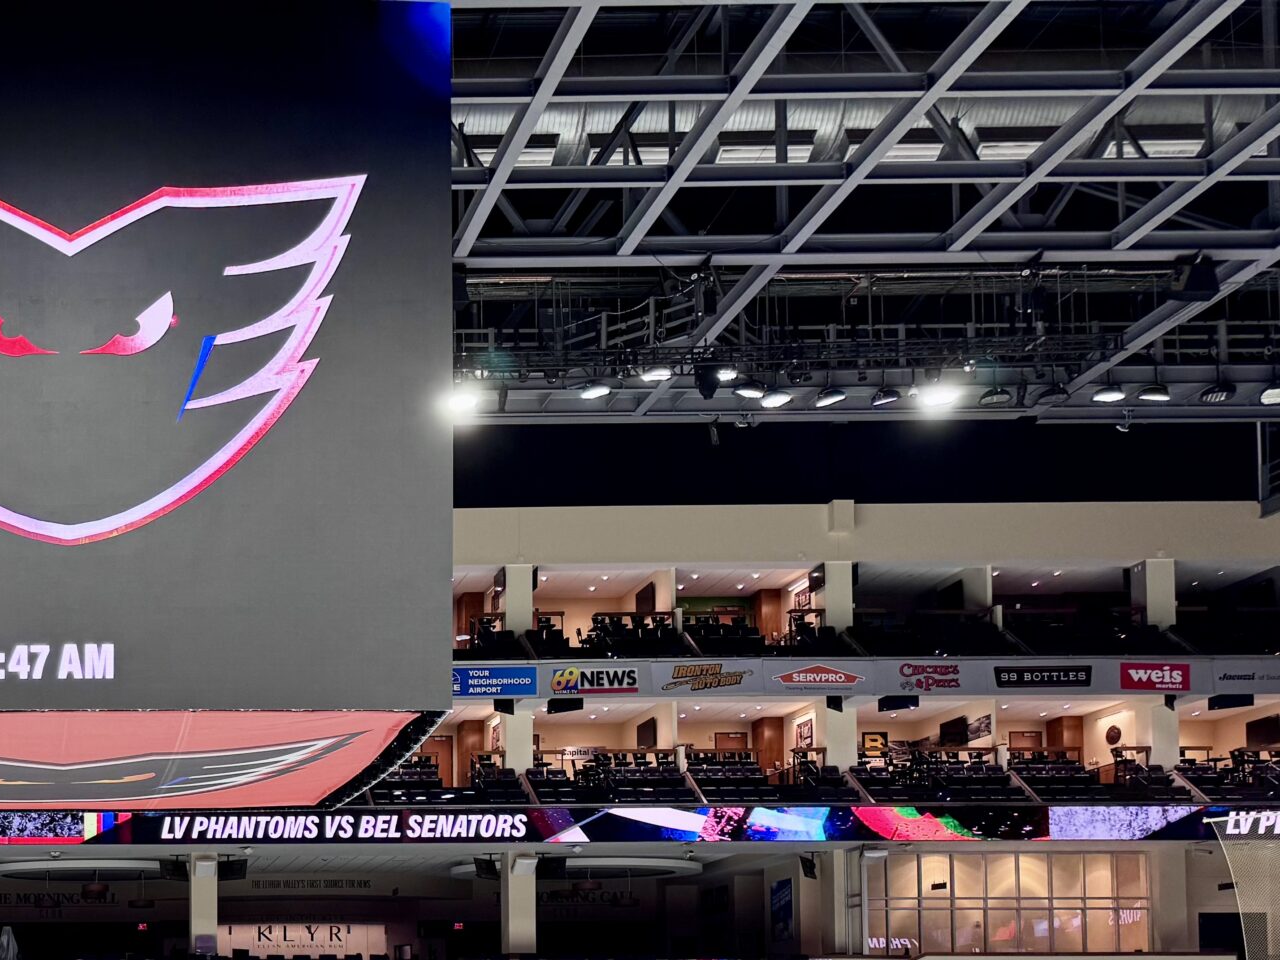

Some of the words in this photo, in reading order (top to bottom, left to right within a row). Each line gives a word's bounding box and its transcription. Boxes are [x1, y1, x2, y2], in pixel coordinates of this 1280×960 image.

[57, 643, 115, 679] AM
[551, 666, 579, 691] 69
[580, 669, 637, 687] NEWS
[672, 663, 722, 679] IRONTON
[792, 672, 845, 682] SERVPRO
[1000, 672, 1018, 681] 99
[1023, 672, 1087, 681] BOTTLES
[1127, 666, 1183, 683] weis
[1219, 672, 1256, 681] Jacuzzi
[468, 677, 532, 685] NEIGHBORHOOD
[691, 678, 719, 691] AUTO
[719, 675, 744, 688] BODY
[468, 686, 502, 694] AIRPORT
[161, 816, 192, 839] LV
[192, 815, 321, 839] PHANTOMS
[324, 815, 354, 838] VS
[358, 815, 402, 839] BEL
[406, 814, 528, 838] SENATORS
[1225, 811, 1257, 835] LV
[257, 925, 342, 942] KLYR
